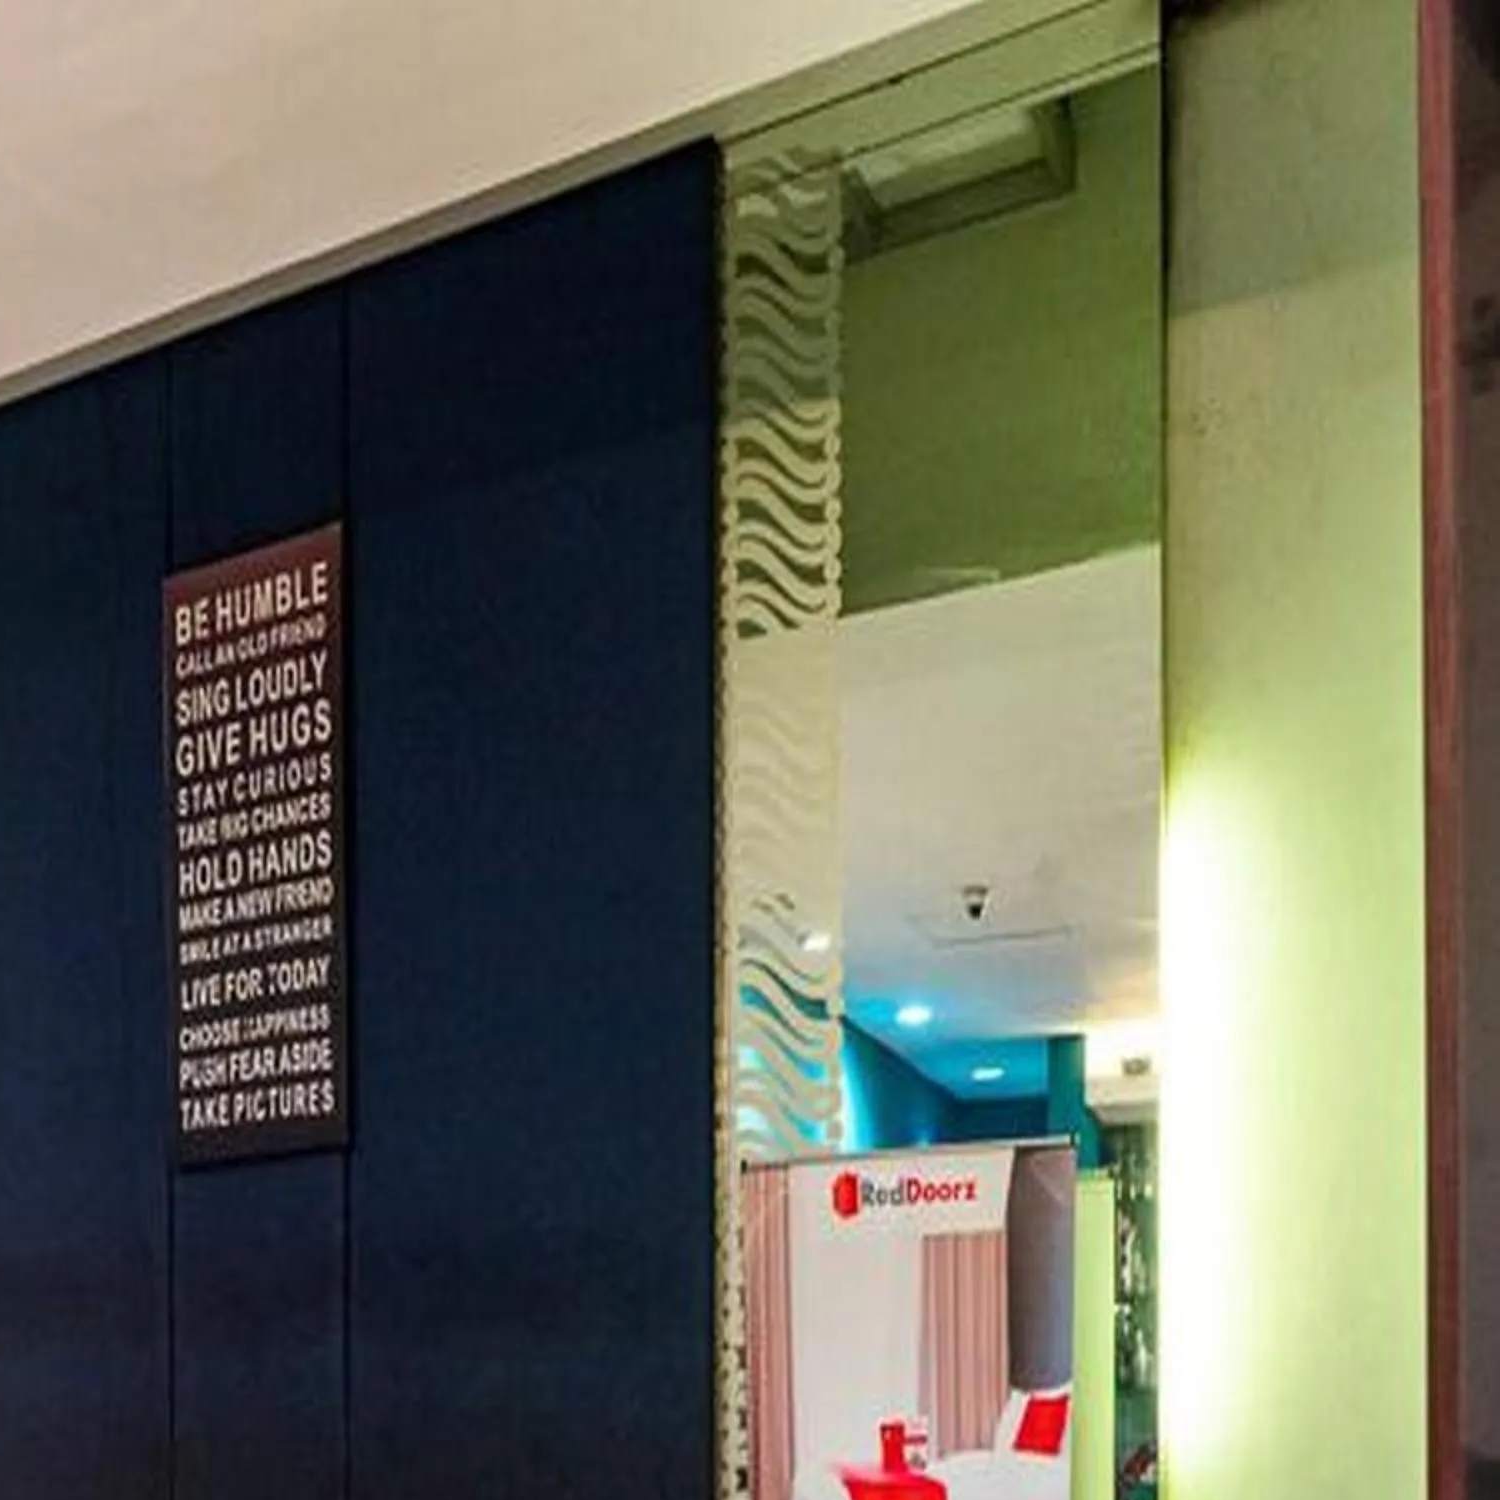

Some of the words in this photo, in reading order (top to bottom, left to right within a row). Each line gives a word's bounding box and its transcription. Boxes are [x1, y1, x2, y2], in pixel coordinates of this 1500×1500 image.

[175, 597, 209, 646] BE
[215, 561, 328, 632] HUMBLE
[175, 678, 230, 727] SING
[235, 650, 327, 712] LOUDLY
[175, 722, 241, 777] GIVE
[249, 698, 332, 758] HUGS
[177, 777, 229, 817] STAY
[232, 752, 332, 799] CURIOUS
[177, 816, 217, 850] TAKE
[251, 791, 332, 837] CHANCES
[179, 850, 242, 899] HOLD
[249, 830, 333, 883] HANDS
[179, 895, 221, 931] MAKE
[275, 875, 334, 913] FRIEND
[181, 972, 221, 1011] LIVE
[225, 967, 263, 1002] FOR
[267, 954, 331, 996] TODAY
[180, 1056, 227, 1091] PUSH
[230, 1047, 275, 1084] FEAR
[279, 1038, 333, 1076] ASIDE
[181, 1094, 229, 1132] TAKE
[233, 1079, 335, 1126] PICTURES
[862, 1176, 976, 1207] RedDoorz
